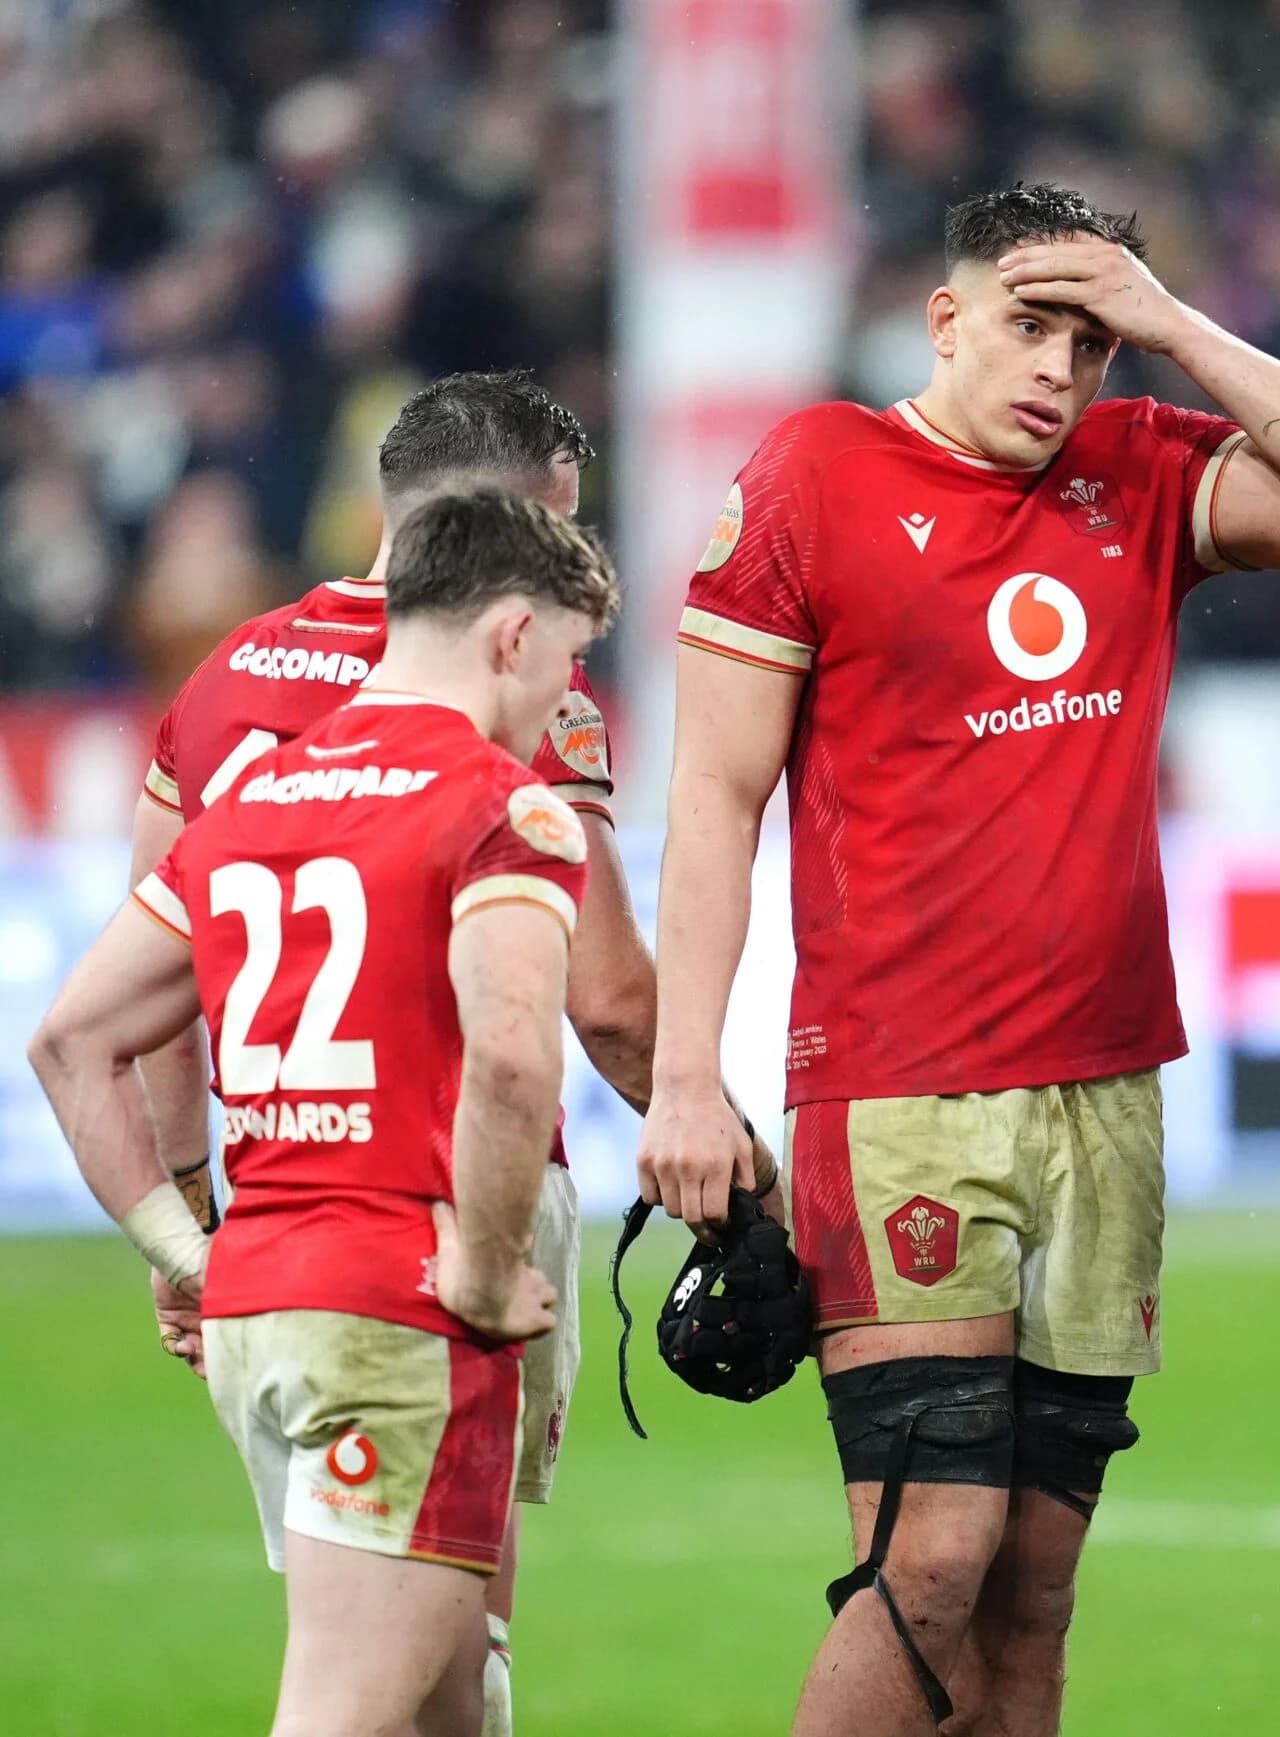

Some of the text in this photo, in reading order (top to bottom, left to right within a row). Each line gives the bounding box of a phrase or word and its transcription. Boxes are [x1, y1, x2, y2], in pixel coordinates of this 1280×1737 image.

[963, 688, 1123, 739] vodafone
[208, 855, 377, 1096] 22
[913, 1255, 936, 1267] WRU
